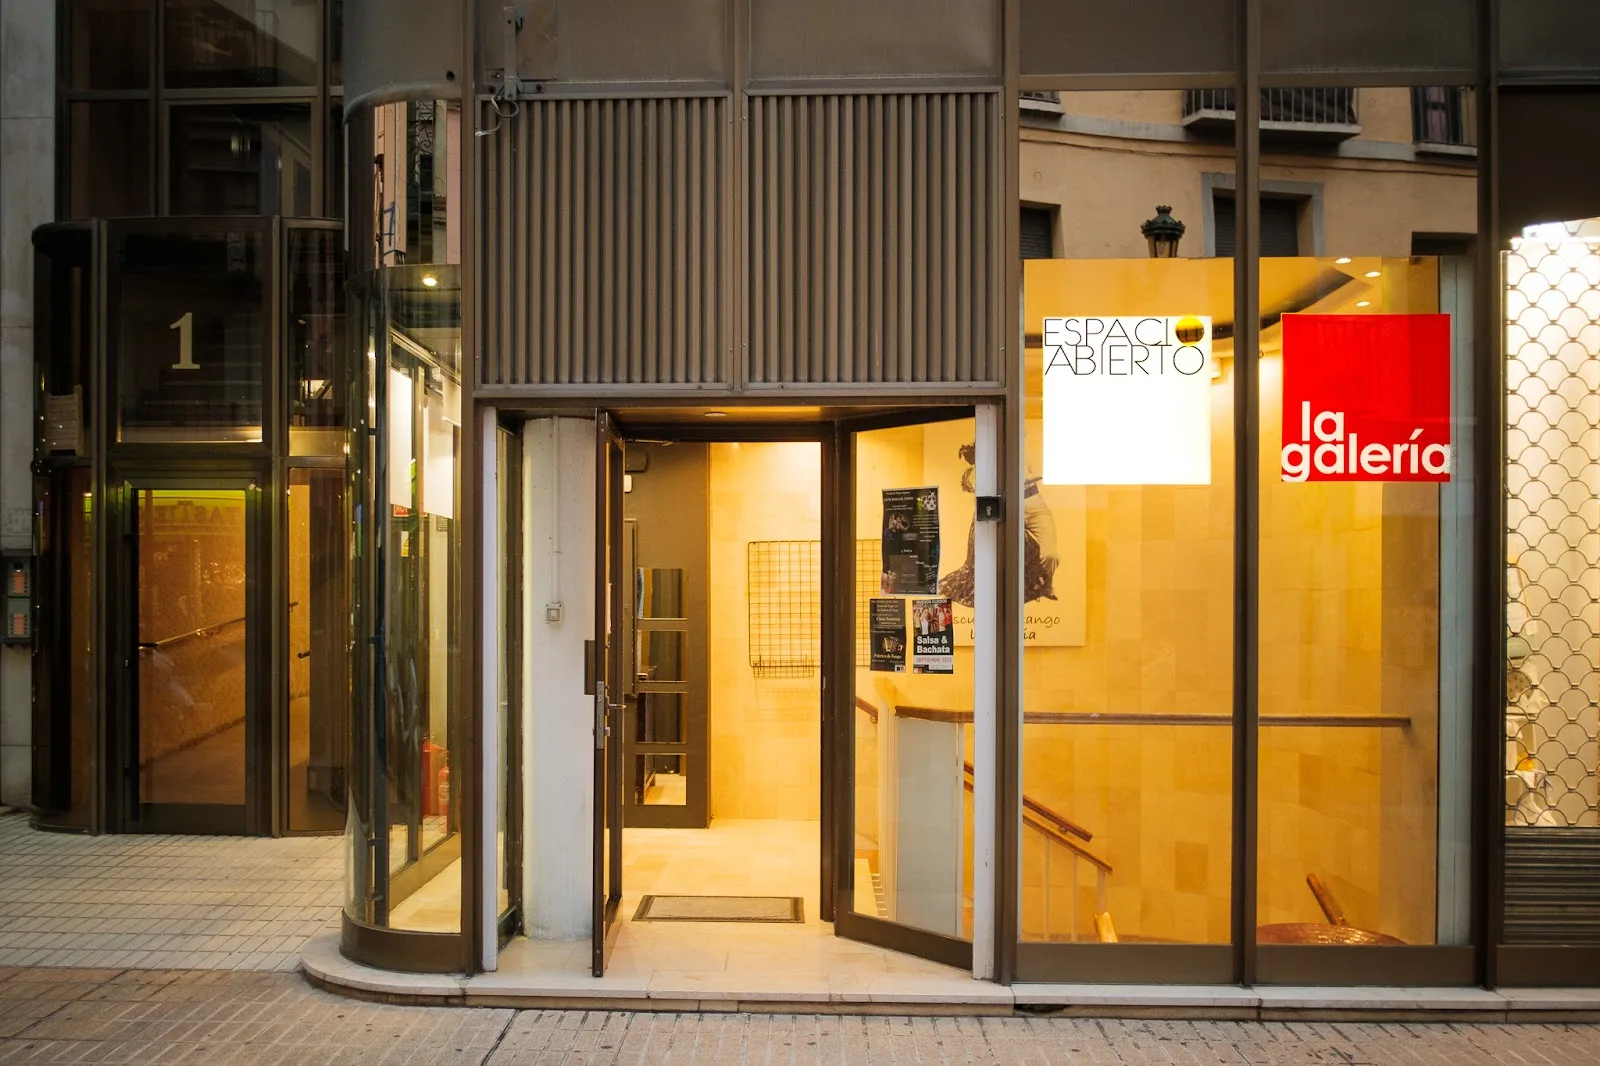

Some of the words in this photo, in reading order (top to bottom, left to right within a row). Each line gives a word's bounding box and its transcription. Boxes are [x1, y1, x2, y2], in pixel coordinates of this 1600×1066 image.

[170, 312, 201, 370] 1
[1044, 315, 1205, 346] ESPACIO
[1044, 345, 1205, 375] ABIERTO
[1301, 401, 1345, 442] la
[1281, 429, 1451, 482] galería
[1024, 615, 1061, 628] ango
[917, 636, 939, 644] Salsa
[941, 635, 948, 644] &
[917, 645, 950, 653] Bachata
